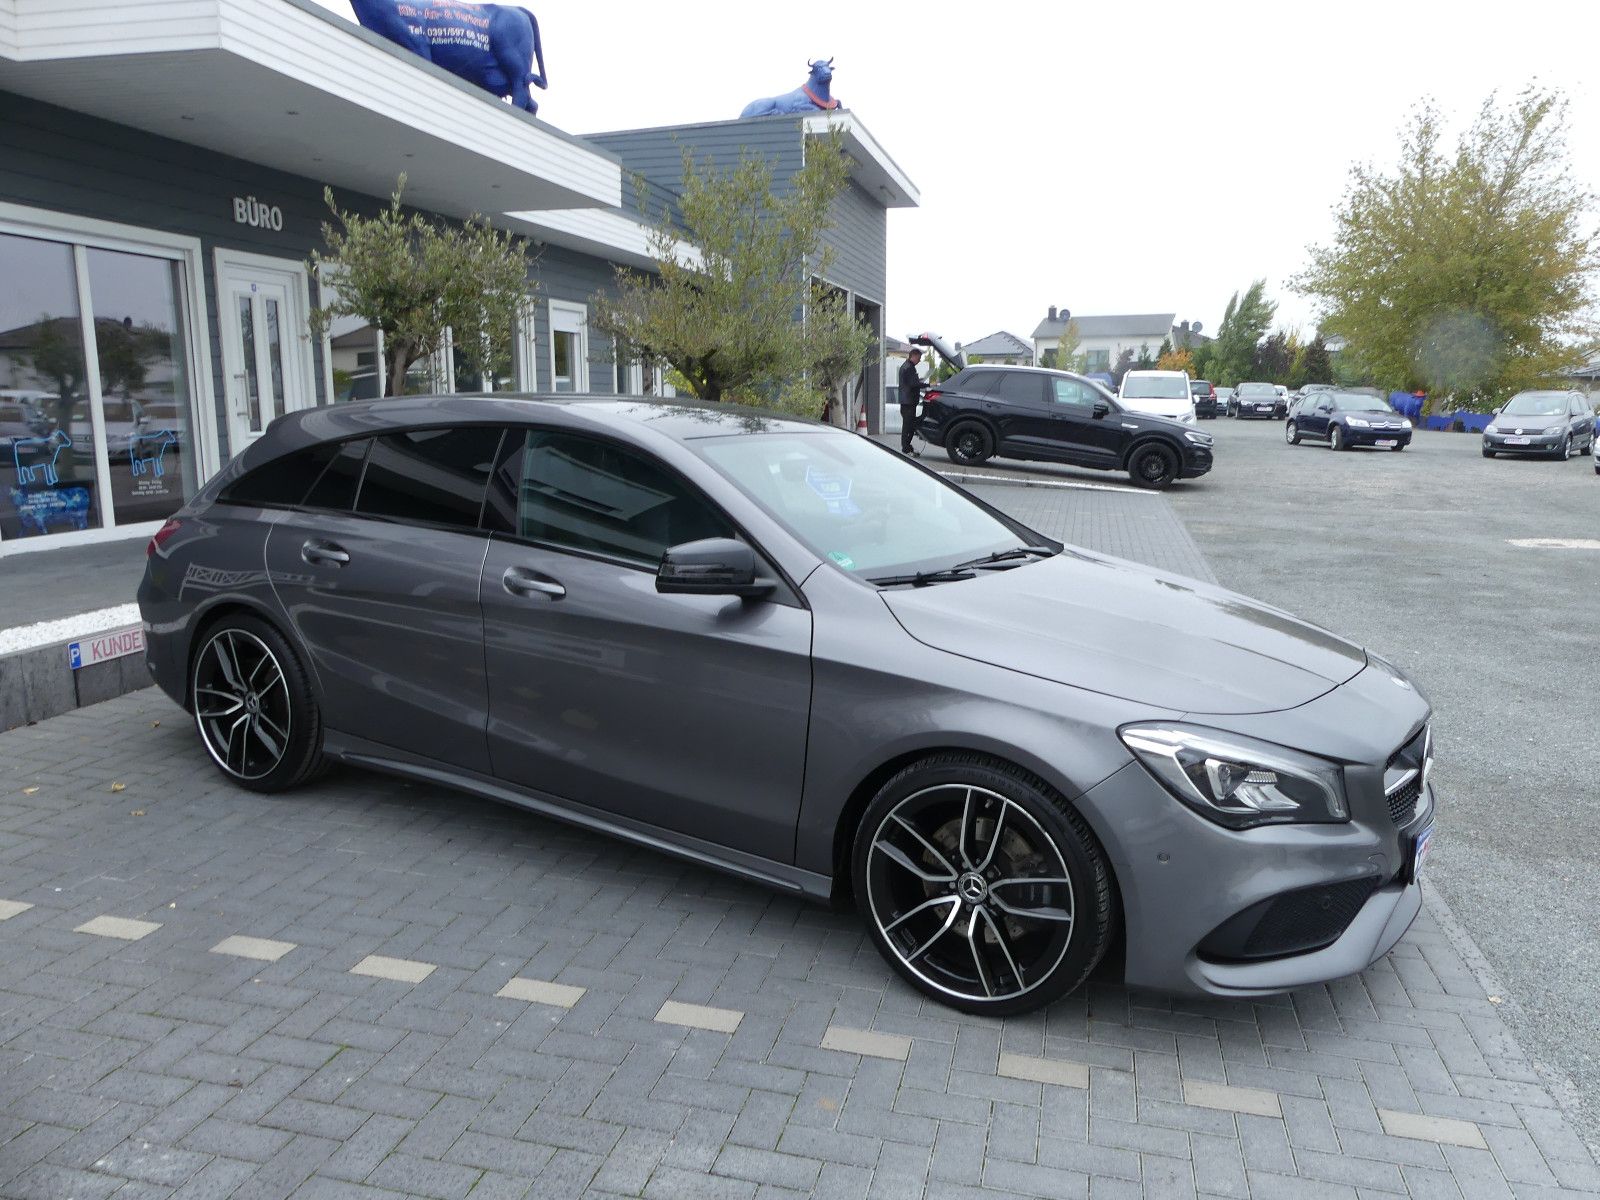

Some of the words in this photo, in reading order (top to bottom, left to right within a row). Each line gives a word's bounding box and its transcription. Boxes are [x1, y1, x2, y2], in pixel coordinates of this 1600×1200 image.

[408, 25, 425, 35] Tel.
[476, 32, 489, 44] 100
[233, 196, 283, 232] BÜRO
[71, 648, 80, 663] P
